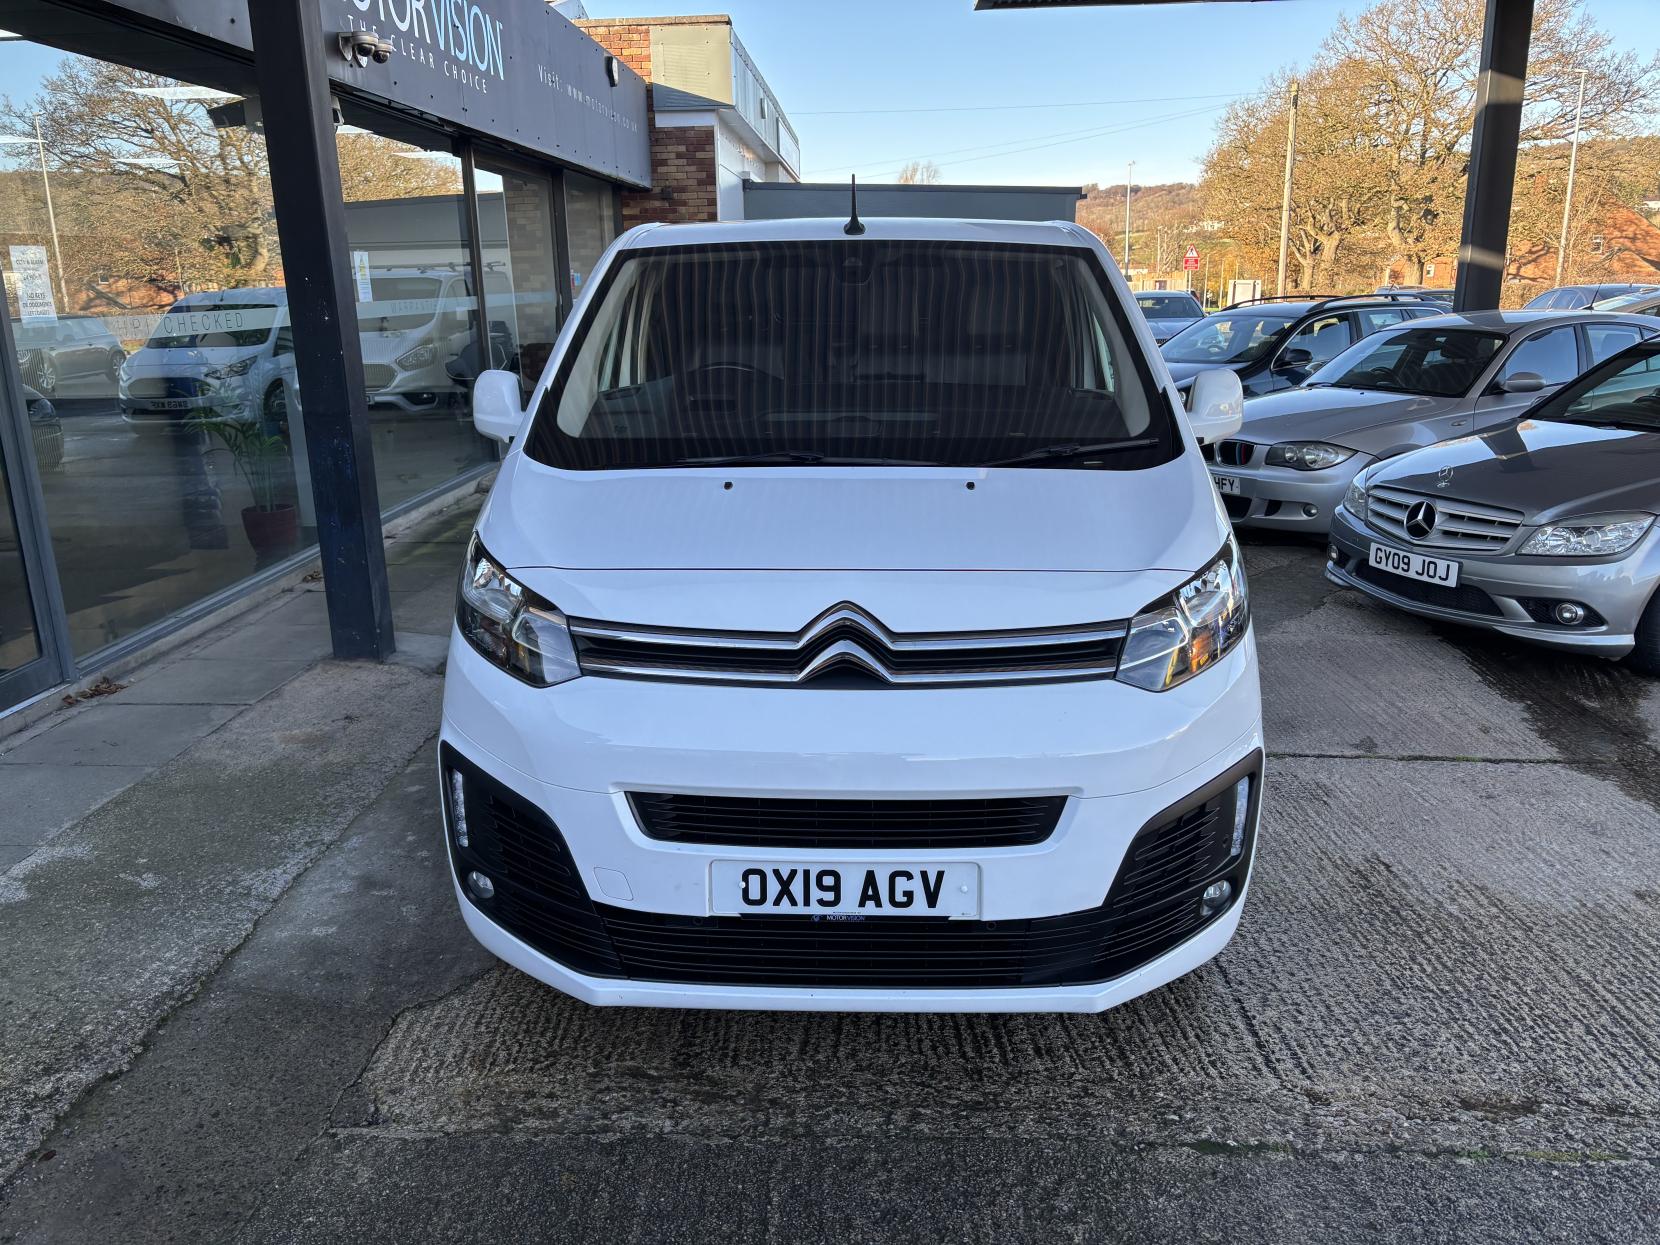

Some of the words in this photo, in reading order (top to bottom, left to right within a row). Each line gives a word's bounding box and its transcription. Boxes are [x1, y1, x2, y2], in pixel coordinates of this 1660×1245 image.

[443, 60, 487, 94] CHOICE
[163, 312, 244, 334] CHECKED
[1374, 547, 1411, 573] GY09
[1415, 559, 1451, 582] JOJ
[741, 868, 842, 908] OX19
[857, 869, 945, 909] AGV
